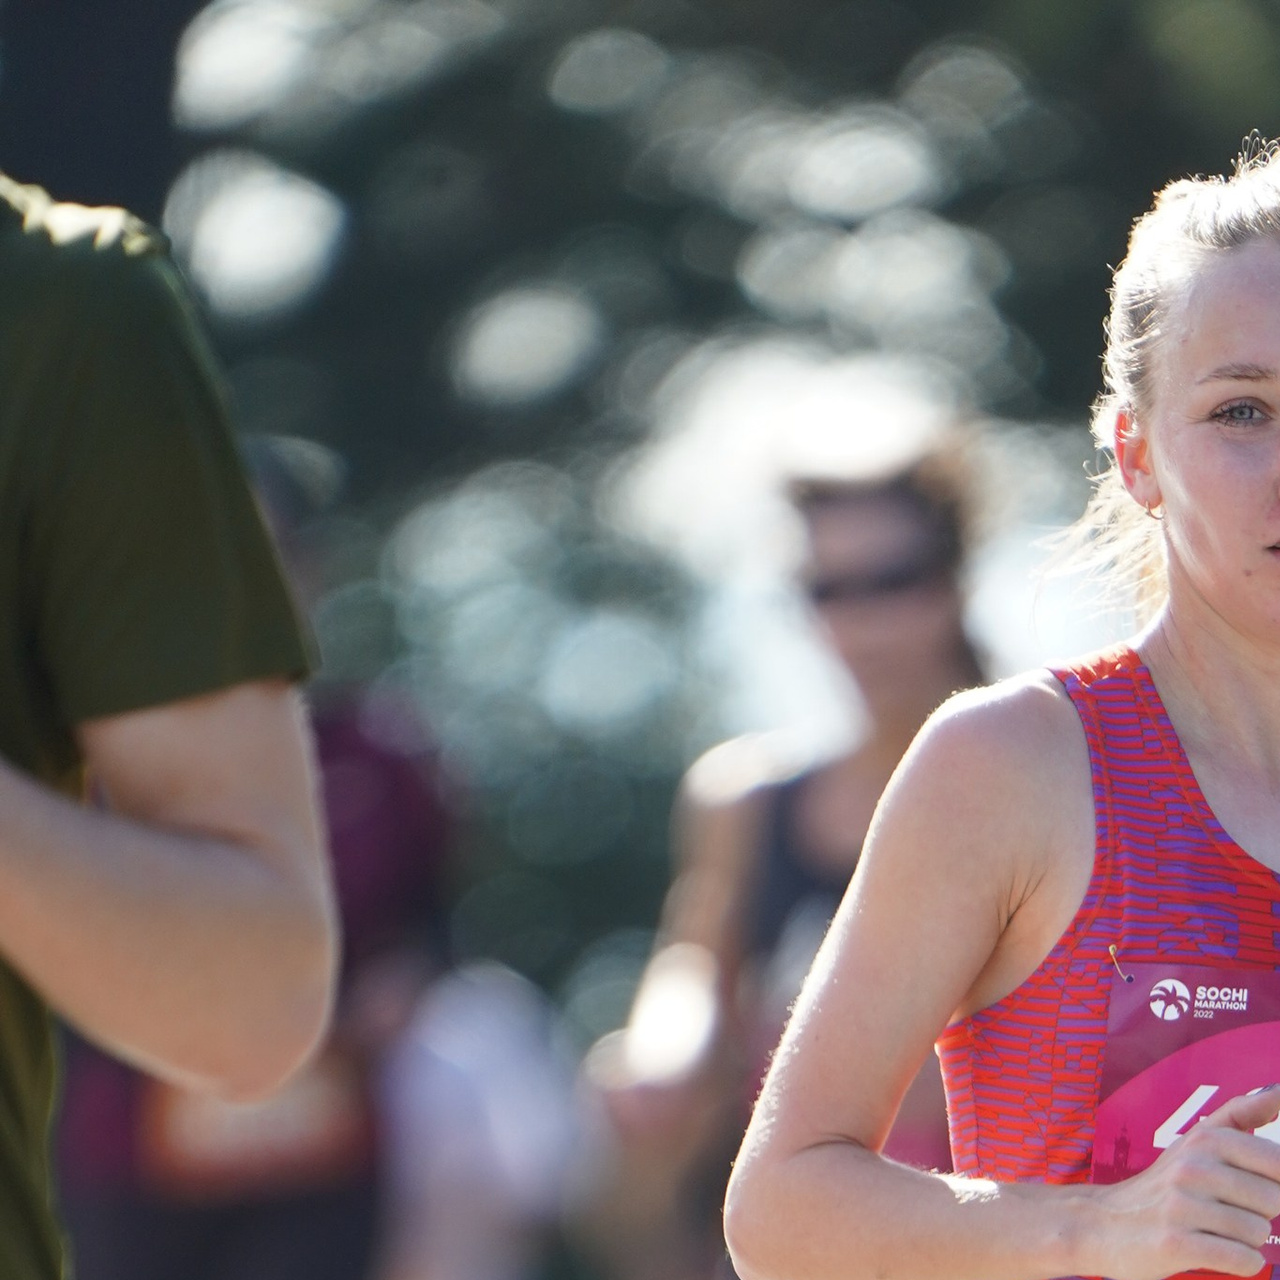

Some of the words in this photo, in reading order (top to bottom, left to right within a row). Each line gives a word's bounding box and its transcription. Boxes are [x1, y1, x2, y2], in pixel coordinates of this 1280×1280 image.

[1195, 985, 1248, 1002] SOCHI
[1194, 999, 1247, 1011] MARATHON
[1193, 1009, 1214, 1019] 2022
